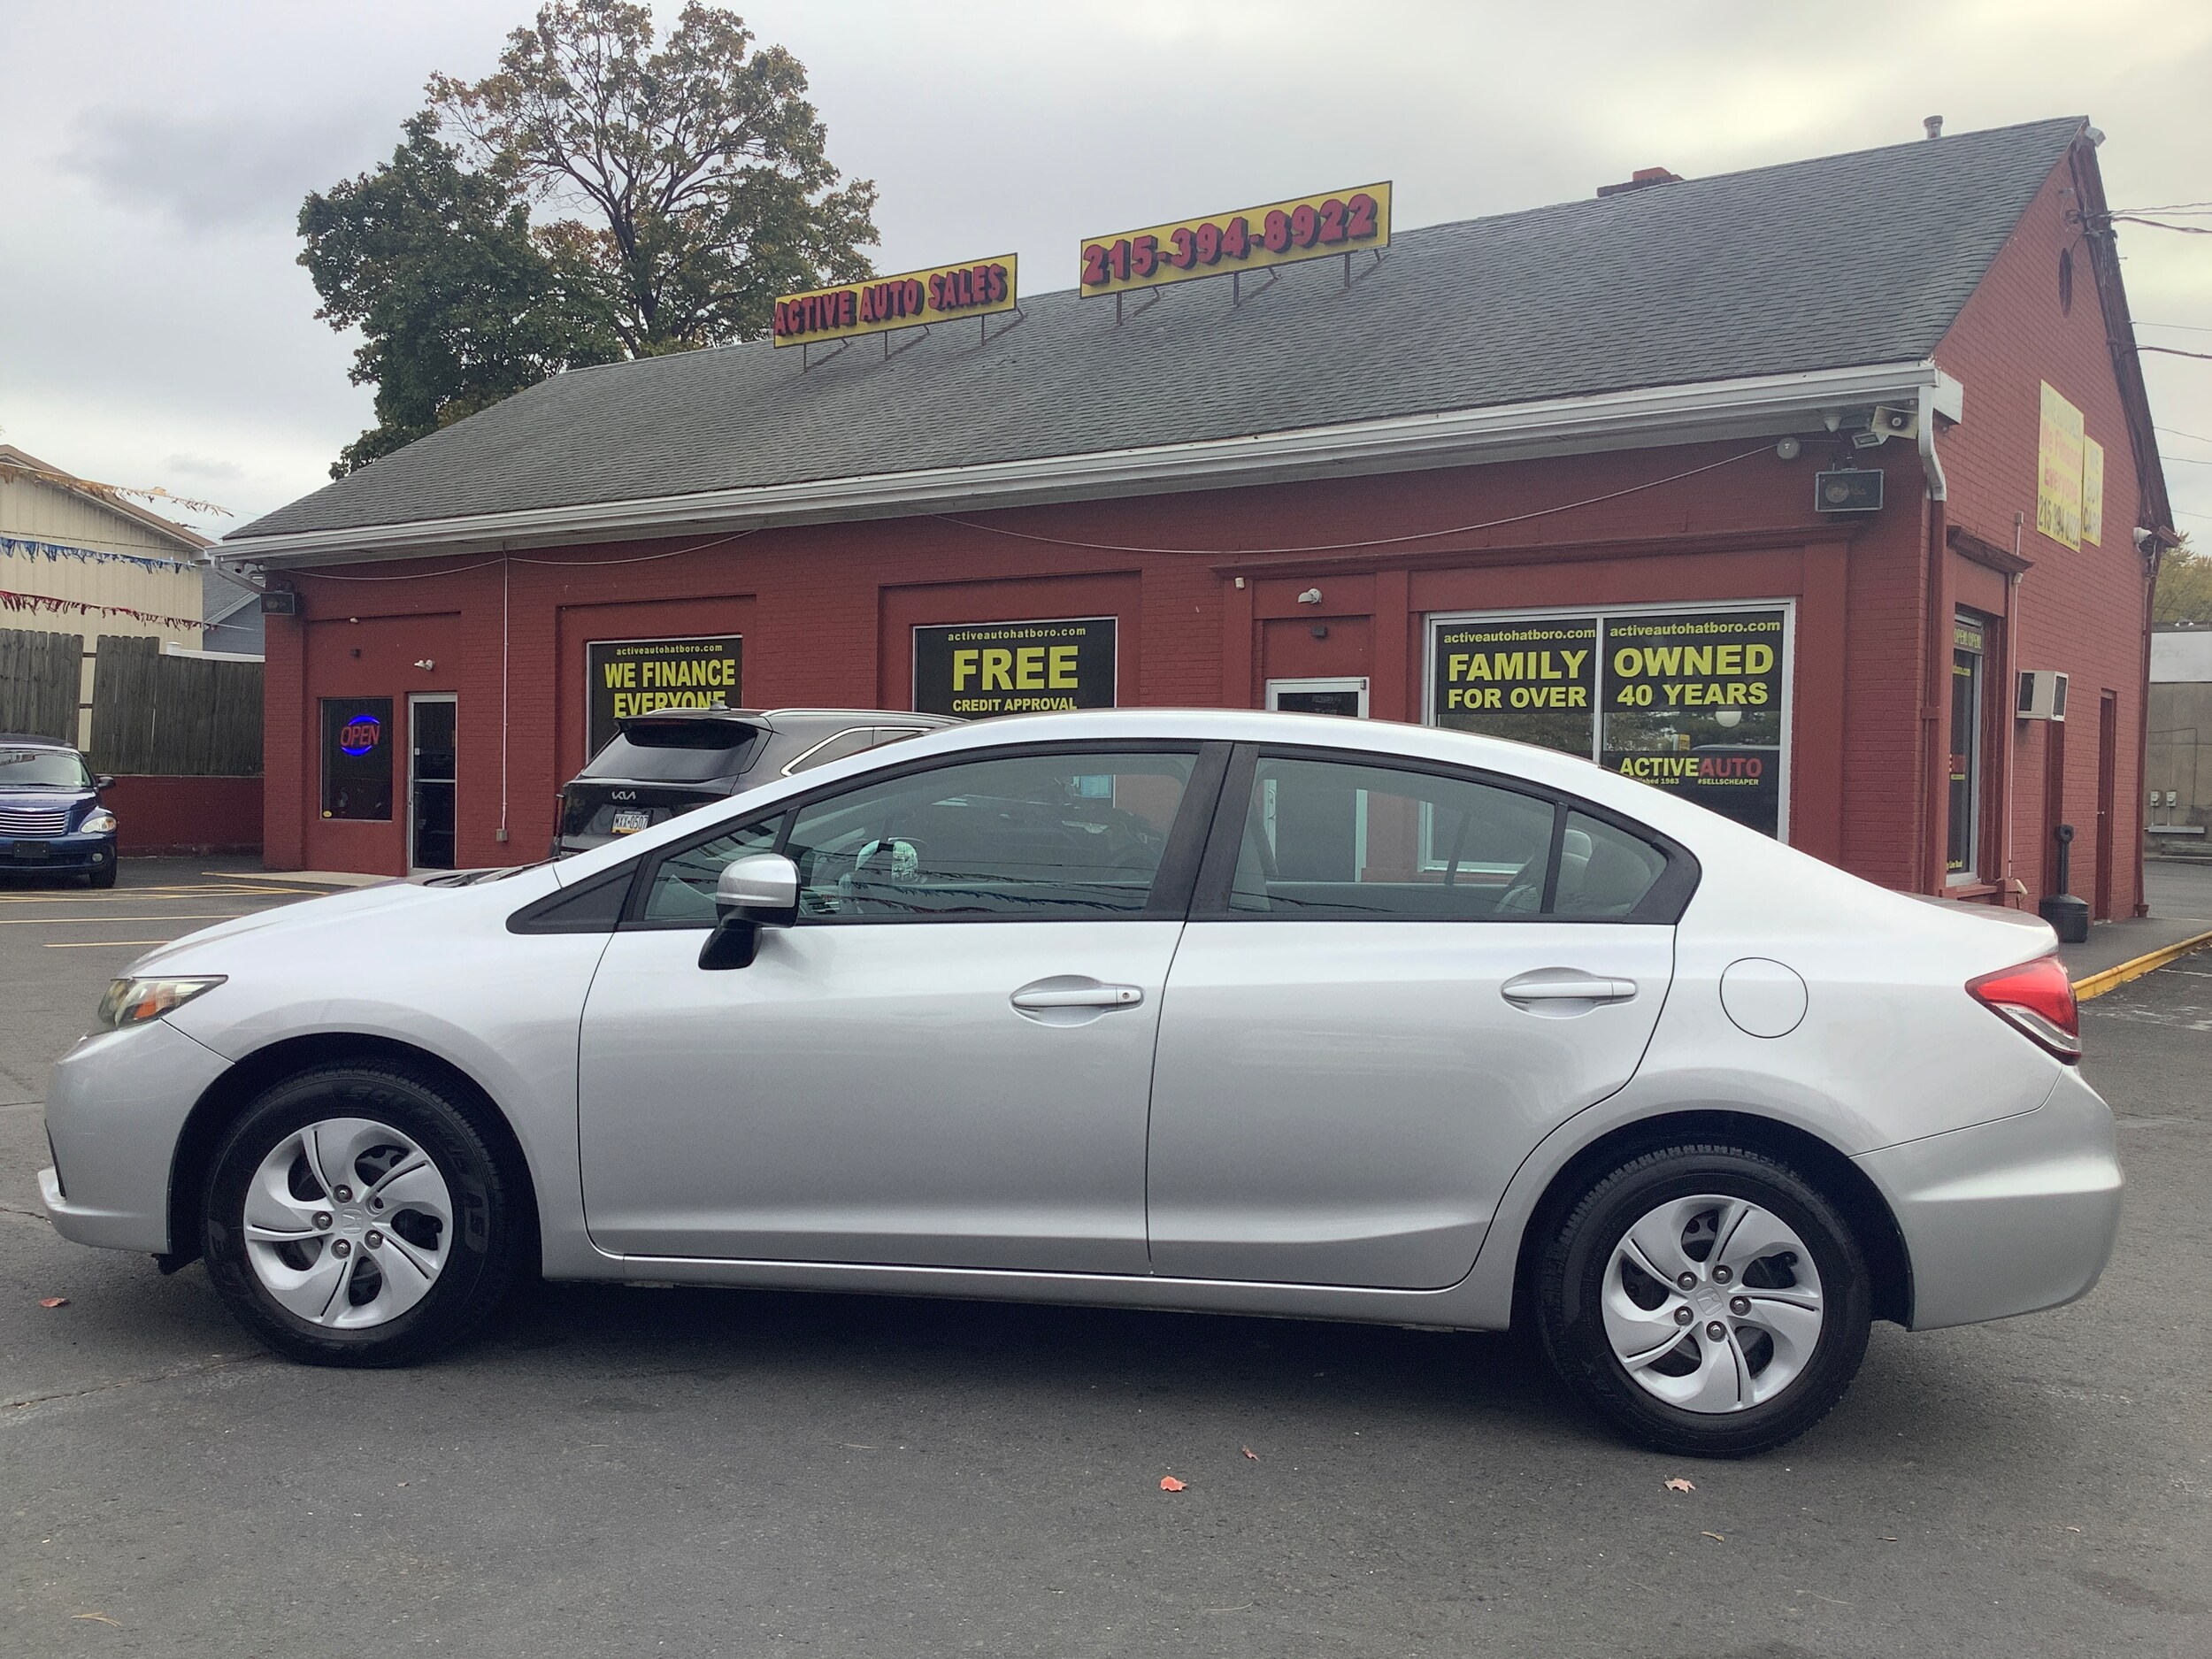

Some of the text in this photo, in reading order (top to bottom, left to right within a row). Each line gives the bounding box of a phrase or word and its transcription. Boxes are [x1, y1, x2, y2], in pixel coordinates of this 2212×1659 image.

[1082, 194, 1378, 286] 215-394-8922
[773, 264, 1008, 336] ACTIVE AUTO SALES
[948, 627, 1086, 641] activeautohatboro.com
[1444, 627, 1596, 643] activeautohatboro.com
[1609, 620, 1780, 637] activeautohatboro.com
[617, 644, 723, 656] activeautohatboro.com
[1614, 643, 1774, 678] OWNED
[604, 659, 735, 688] WE FINANCE
[953, 645, 1079, 691] FREE
[1448, 649, 1588, 681] FAMILY
[953, 697, 1077, 712] CREDIT APPROVAL
[1448, 686, 1586, 709] FOR OVER
[1617, 681, 1769, 706] 40 YEARS
[340, 725, 380, 747] OPEN
